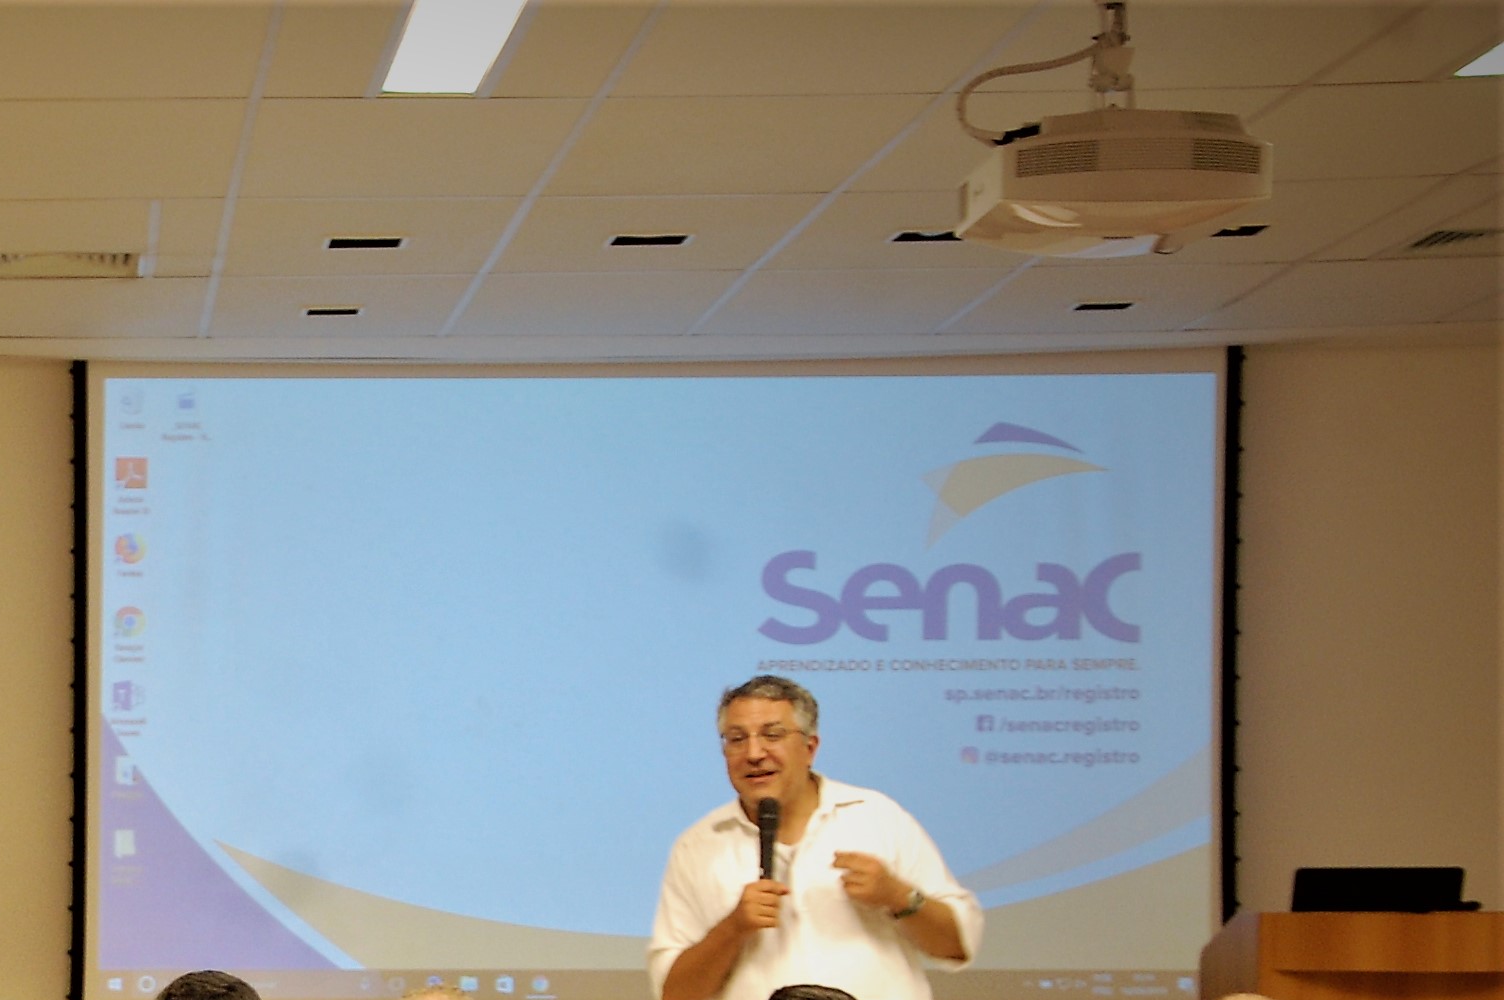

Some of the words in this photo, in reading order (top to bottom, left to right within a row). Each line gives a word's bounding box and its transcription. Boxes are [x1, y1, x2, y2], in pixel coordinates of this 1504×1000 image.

[757, 659, 872, 672] APRENDIZADO
[875, 659, 886, 671] E
[891, 659, 1021, 671] CONHECIMENTO
[1025, 658, 1068, 671] PARA
[944, 685, 1141, 704] sp.senac.br/registro
[984, 749, 1141, 768] @senac.registro
